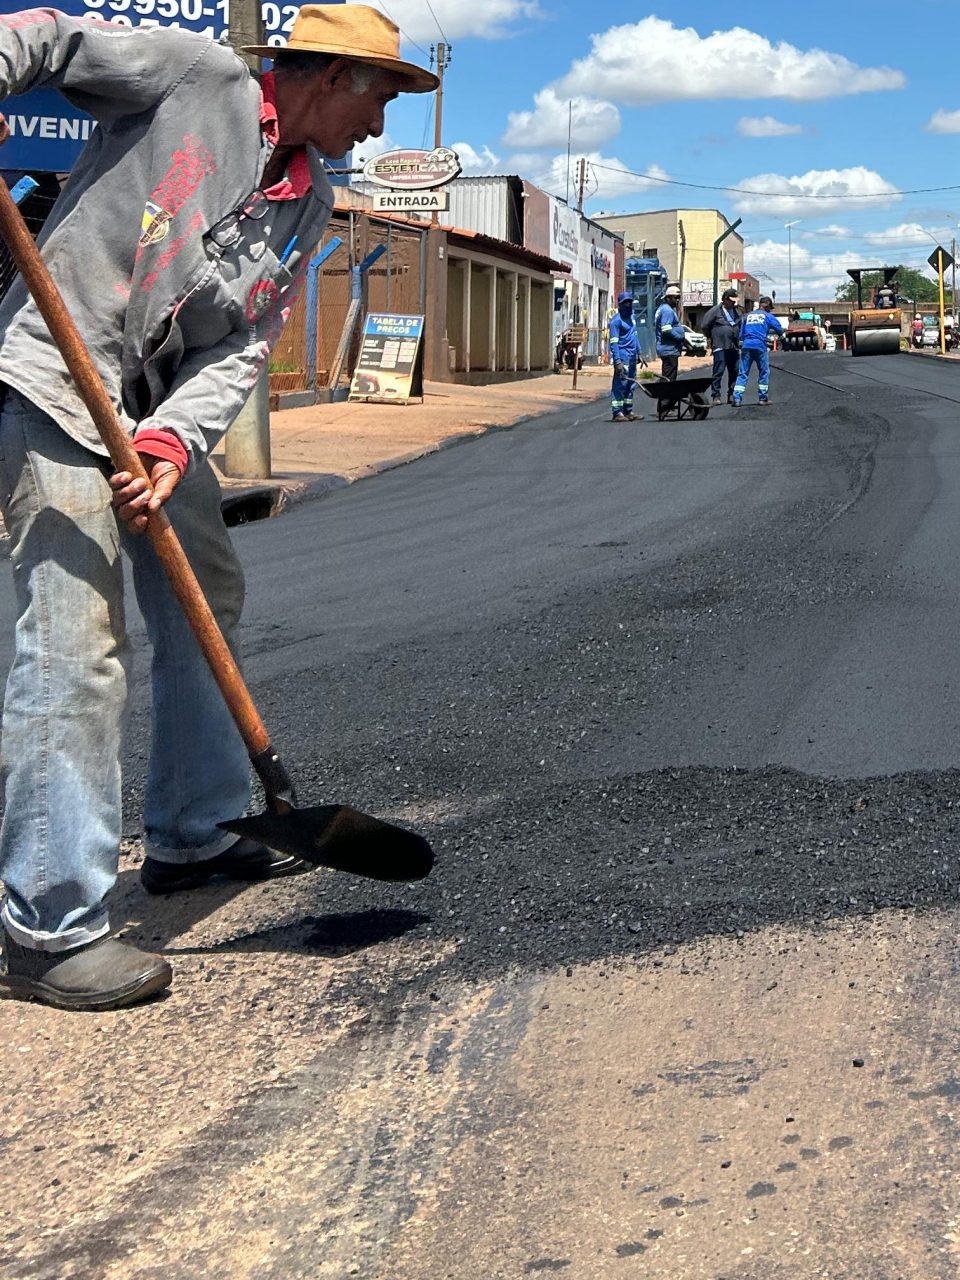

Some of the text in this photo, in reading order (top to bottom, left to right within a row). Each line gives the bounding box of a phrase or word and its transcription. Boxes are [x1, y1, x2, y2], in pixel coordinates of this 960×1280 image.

[5, 114, 98, 140] VENI
[375, 164, 449, 172] ESTETICAR
[380, 196, 438, 206] ENTRADA
[372, 317, 419, 327] TABELA DE
[376, 325, 411, 334] PREÇOS
